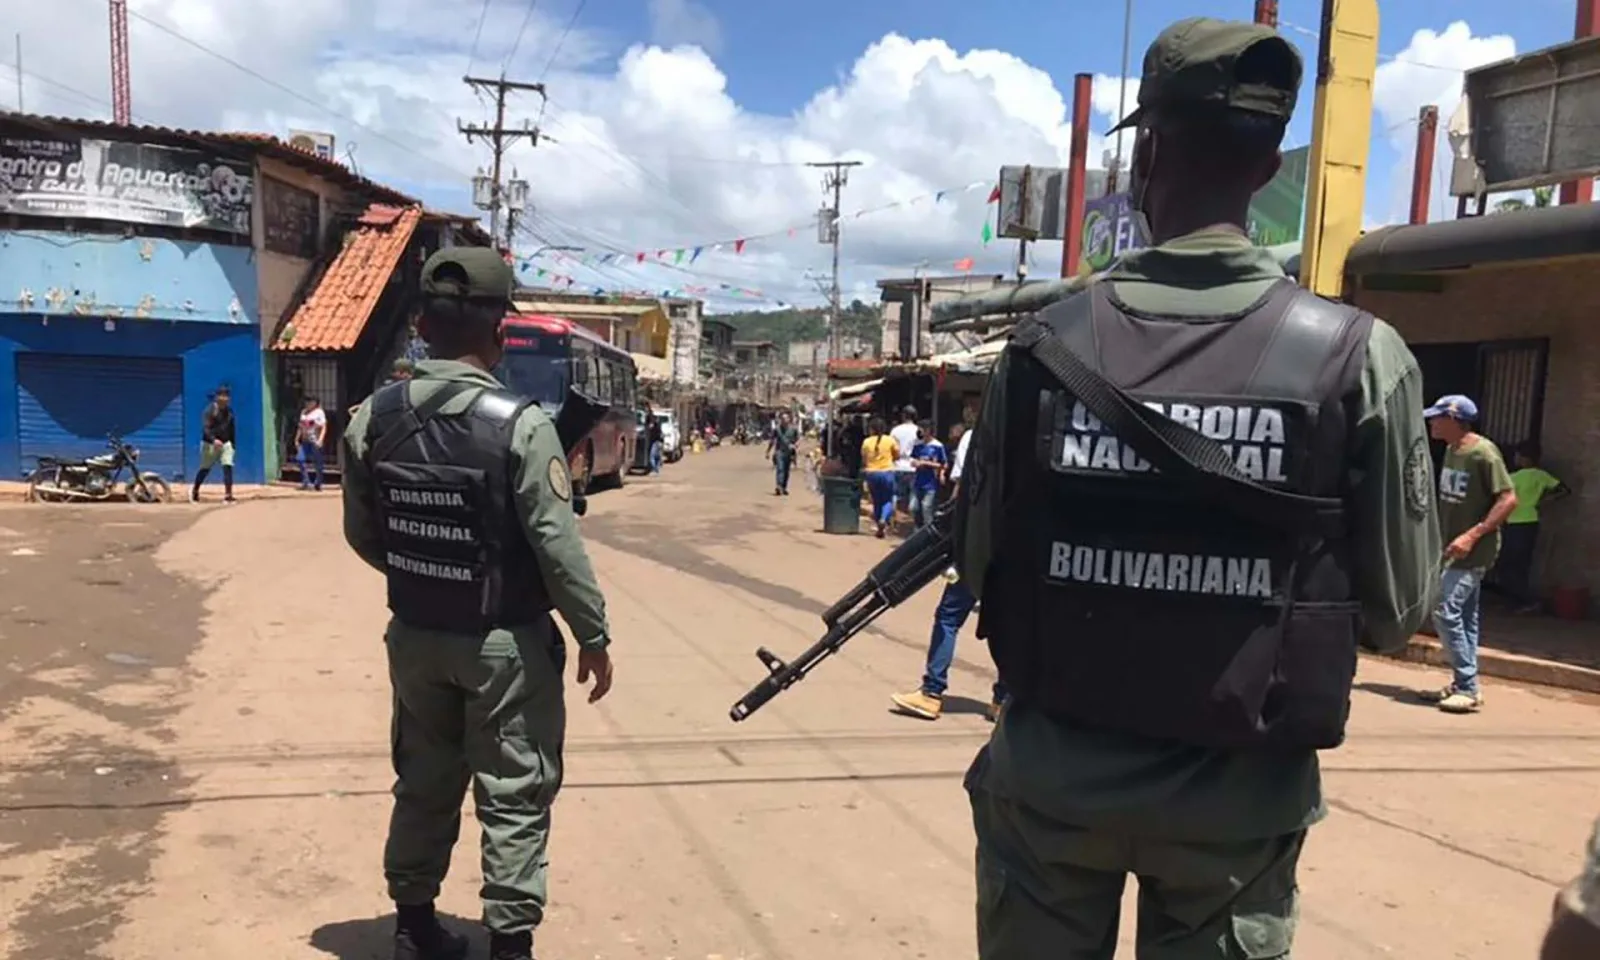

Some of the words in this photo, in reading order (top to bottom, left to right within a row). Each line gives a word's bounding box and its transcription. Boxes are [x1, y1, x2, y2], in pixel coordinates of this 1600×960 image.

[0, 156, 62, 177] entro
[389, 488, 465, 506] GUARDIA
[388, 517, 474, 541] NACIONAL
[387, 551, 473, 581] BOLIVARIANA
[1049, 541, 1273, 598] BOLIVARIANA
